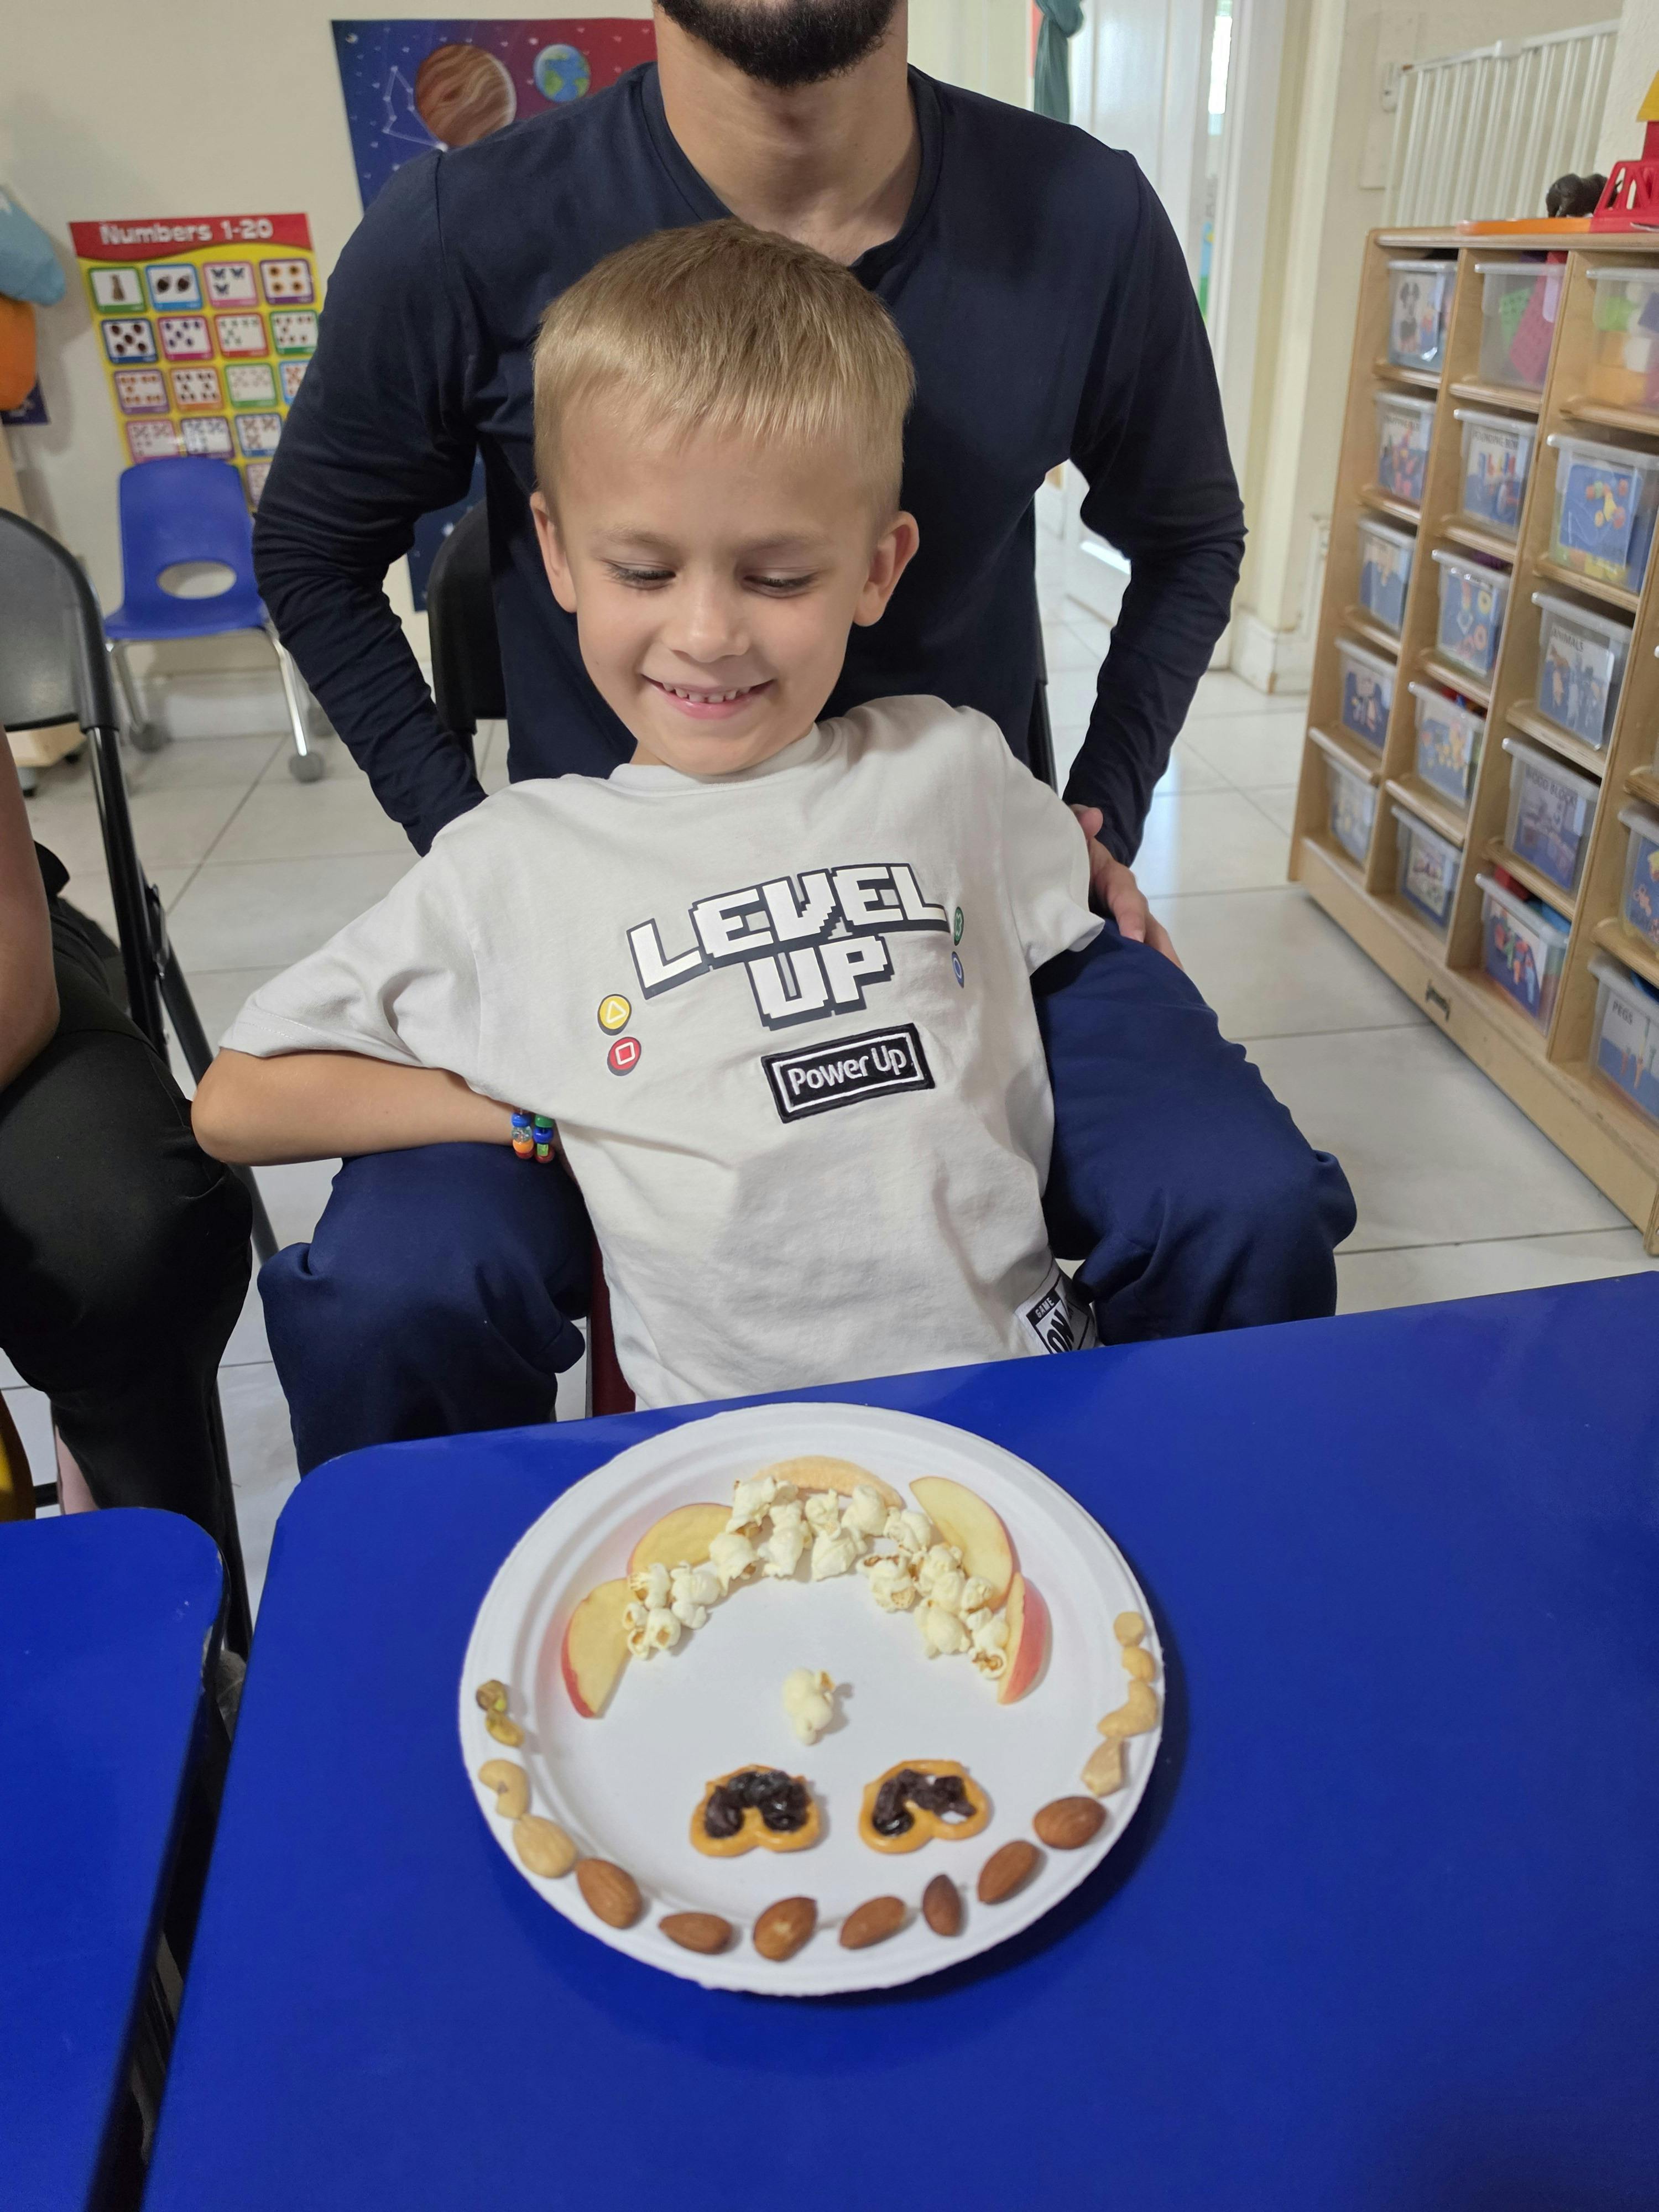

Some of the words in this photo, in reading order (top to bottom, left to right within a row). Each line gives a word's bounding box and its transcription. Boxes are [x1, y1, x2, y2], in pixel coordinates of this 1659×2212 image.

[99, 222, 213, 244] Numbers
[221, 218, 274, 240] 1-20
[1551, 628, 1583, 653] ANIMALS
[627, 863, 950, 999] LEVEL
[745, 936, 895, 1031] UP
[1613, 1000, 1633, 1026] PEGS
[787, 1055, 869, 1095] Power
[871, 1045, 907, 1076] Up
[1035, 1297, 1055, 1318] GAME
